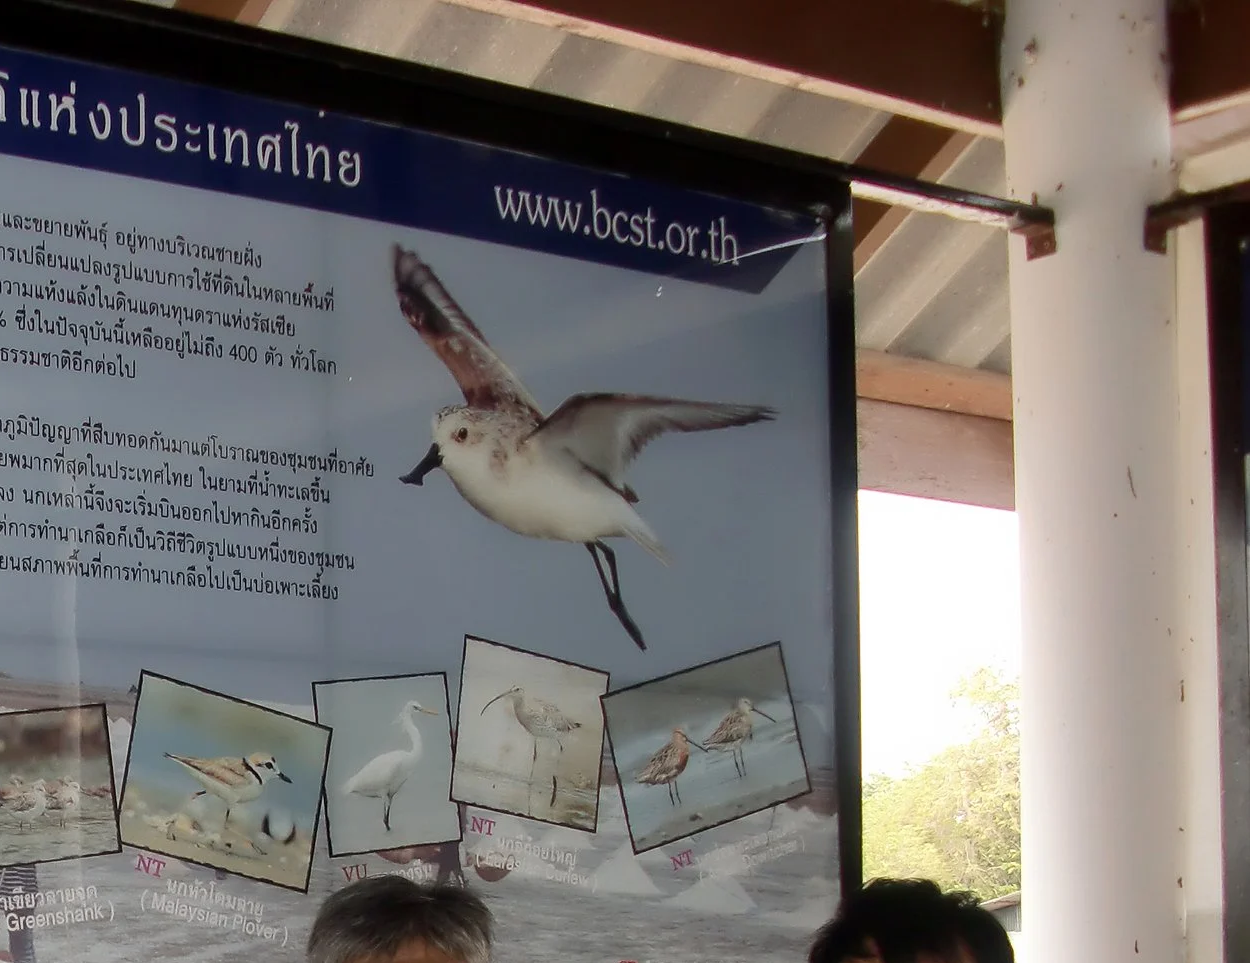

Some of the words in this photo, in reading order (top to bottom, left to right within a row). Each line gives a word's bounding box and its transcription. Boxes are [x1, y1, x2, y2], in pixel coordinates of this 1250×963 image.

[493, 184, 740, 266] www.bcst.or.th
[115, 226, 262, 270] อยู่ทางบริเวณชายฝั่ง
[228, 343, 258, 364] 400
[264, 345, 283, 367] ตัว
[290, 344, 337, 375] ทั่วโลก
[198, 466, 330, 504] ในยามที่น้ำทะเลขึ้น
[470, 816, 496, 836] NT
[134, 853, 167, 878] NT
[342, 863, 368, 883] VU
[670, 849, 693, 871] NT
[6, 905, 105, 933] Greenshank
[151, 892, 229, 929] Malaysian
